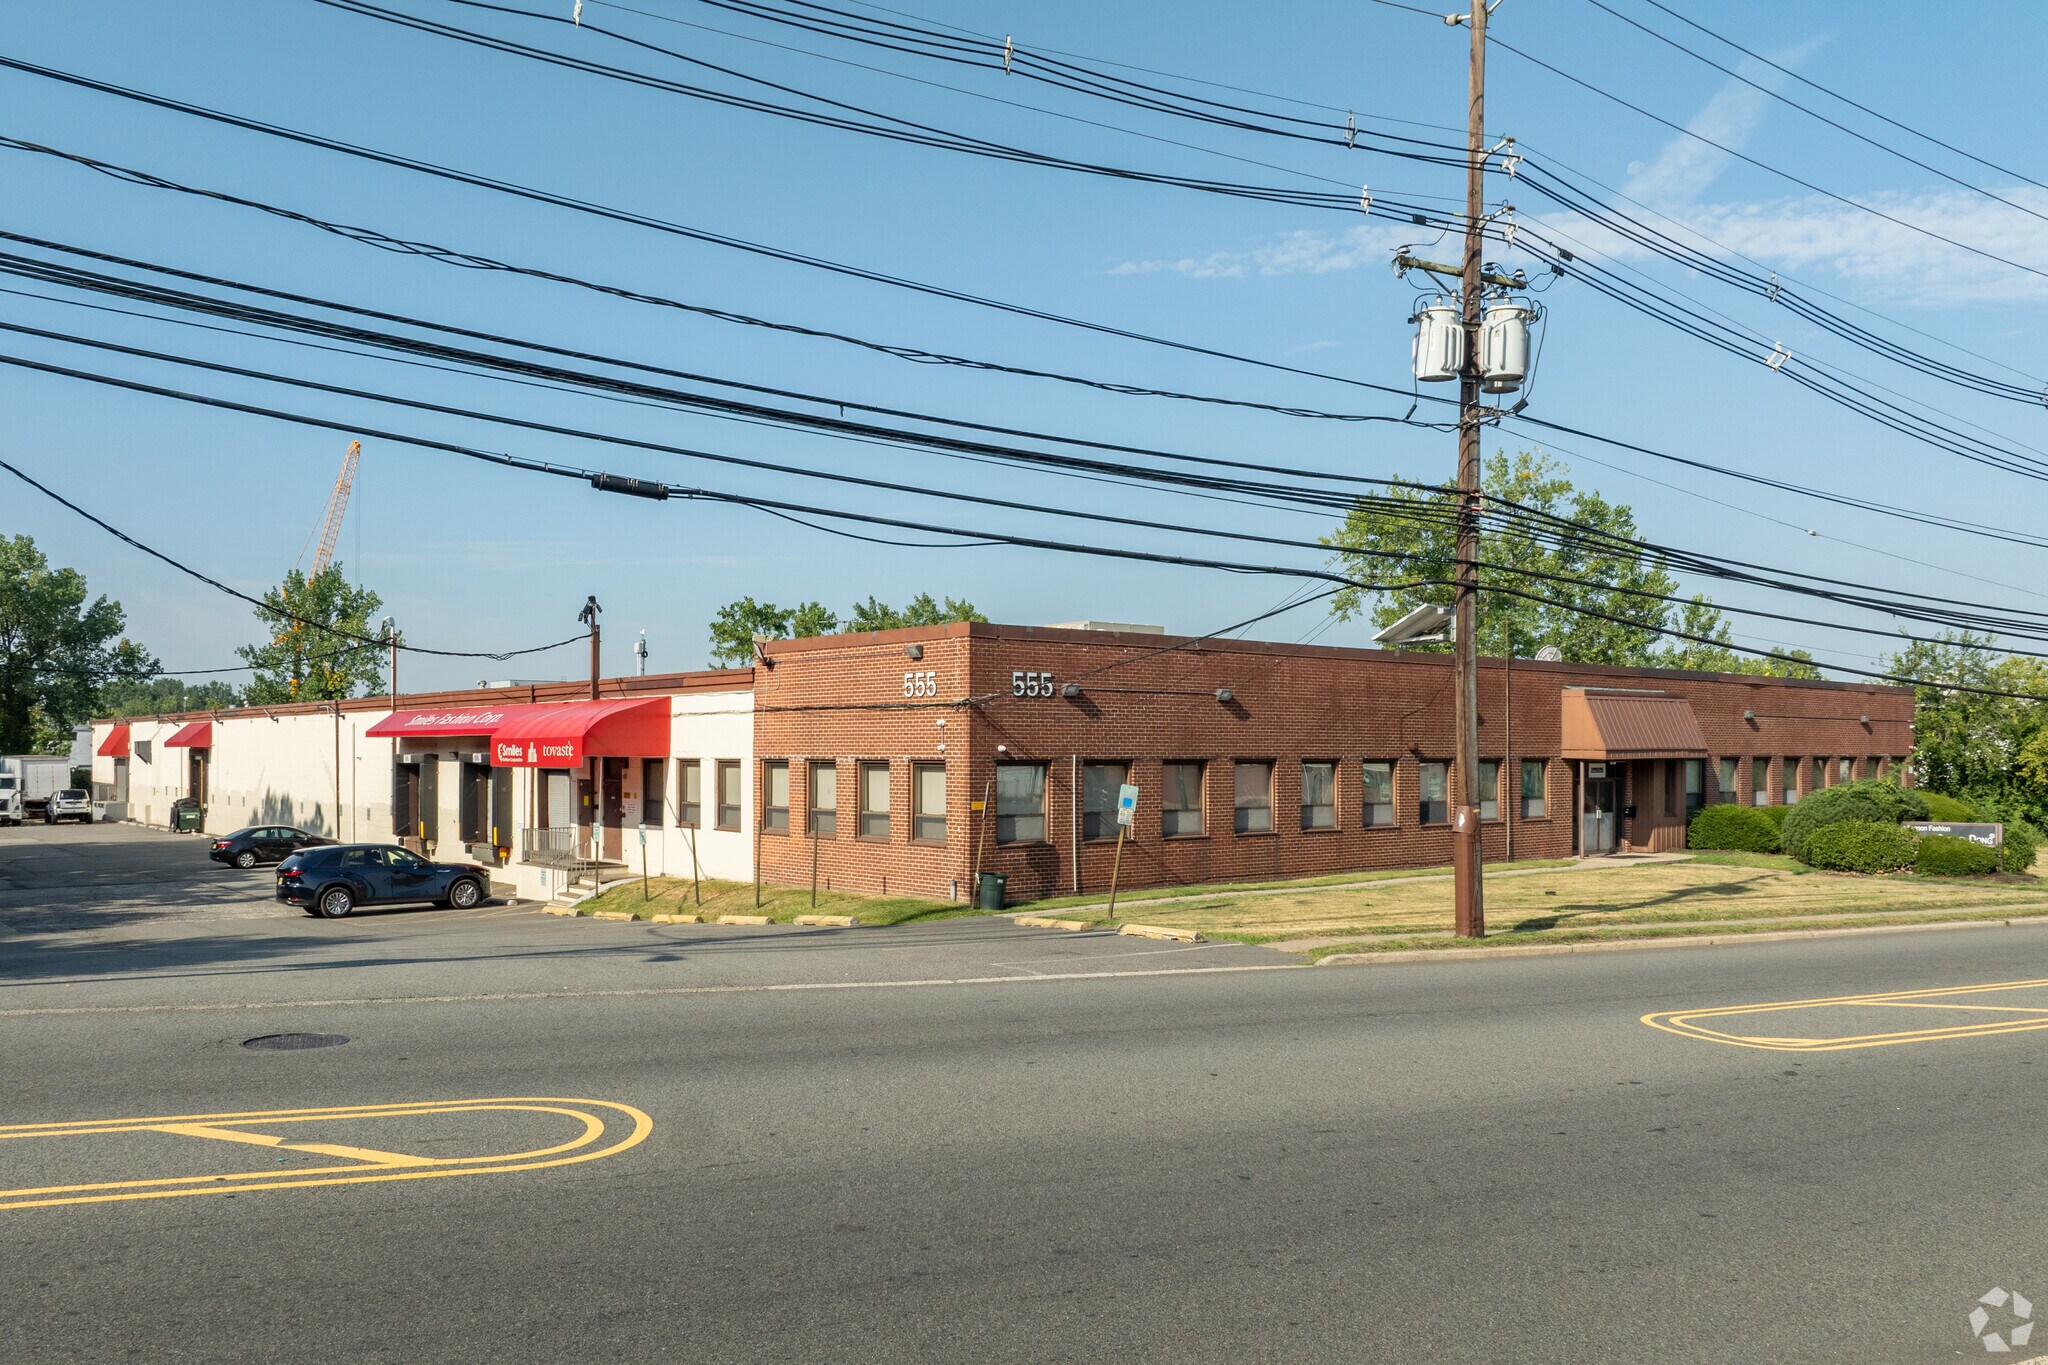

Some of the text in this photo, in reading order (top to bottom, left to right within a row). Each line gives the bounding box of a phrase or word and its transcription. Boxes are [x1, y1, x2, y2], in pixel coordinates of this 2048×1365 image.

[904, 671, 937, 698] 555
[1012, 671, 1054, 697] 555
[404, 714, 440, 726] Smiles
[502, 744, 523, 757] Smiles
[1928, 824, 1951, 832] Fashion
